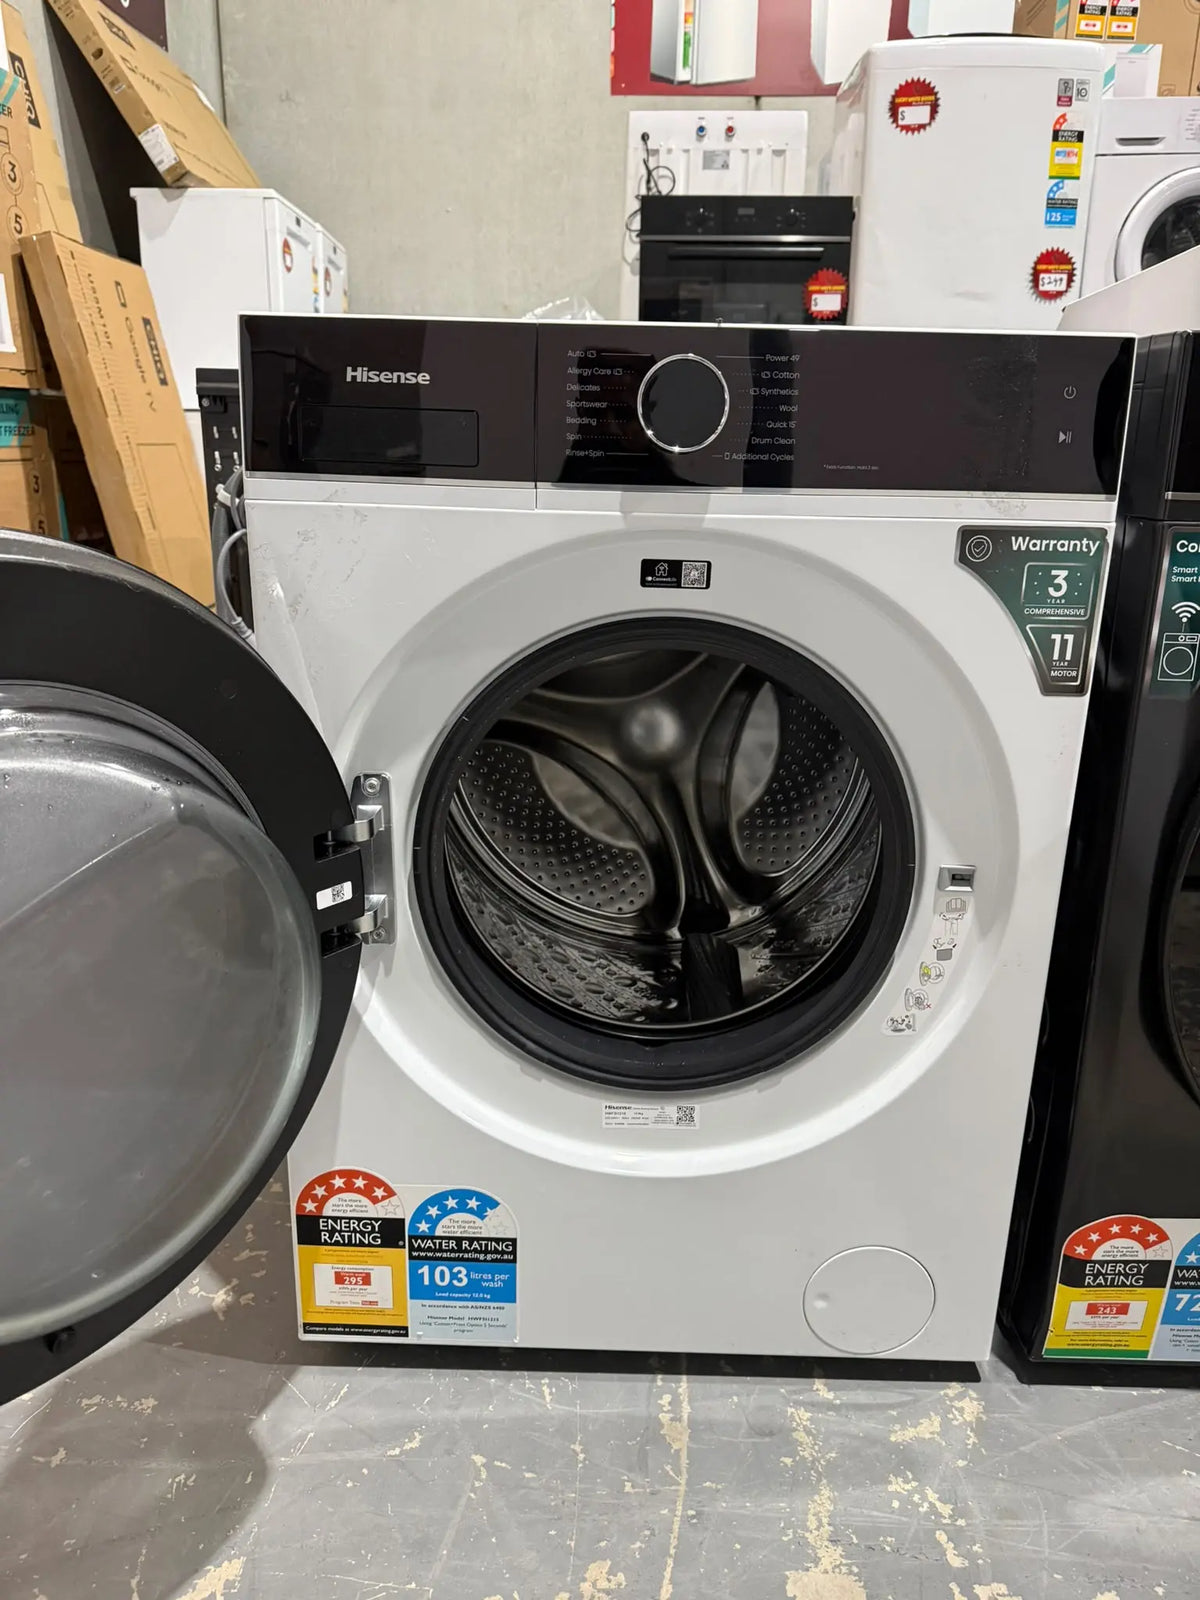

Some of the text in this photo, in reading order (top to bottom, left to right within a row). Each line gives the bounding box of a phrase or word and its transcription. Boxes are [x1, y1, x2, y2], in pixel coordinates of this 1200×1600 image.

[8, 161, 17, 184] 3
[13, 214, 23, 236] 5
[346, 366, 430, 384] Hisense
[567, 367, 592, 376] Allergy
[760, 388, 799, 396] Synthetics
[566, 417, 597, 426] Bedding
[566, 449, 604, 458] Rinse+Spin
[770, 453, 794, 462] Cycles
[33, 476, 40, 494] 3
[1011, 536, 1100, 556] Warranty
[1048, 570, 1068, 597] 3
[1051, 634, 1074, 661] 11
[320, 1219, 382, 1232] ENERGY
[321, 1232, 381, 1244] RATING
[412, 1239, 512, 1251] WATER RATING
[412, 1251, 514, 1260] www.waterrating.gov.au
[1085, 1263, 1149, 1274] ENERGY
[344, 1277, 362, 1285] 295
[418, 1265, 468, 1287] 103
[1084, 1275, 1144, 1286] RATING
